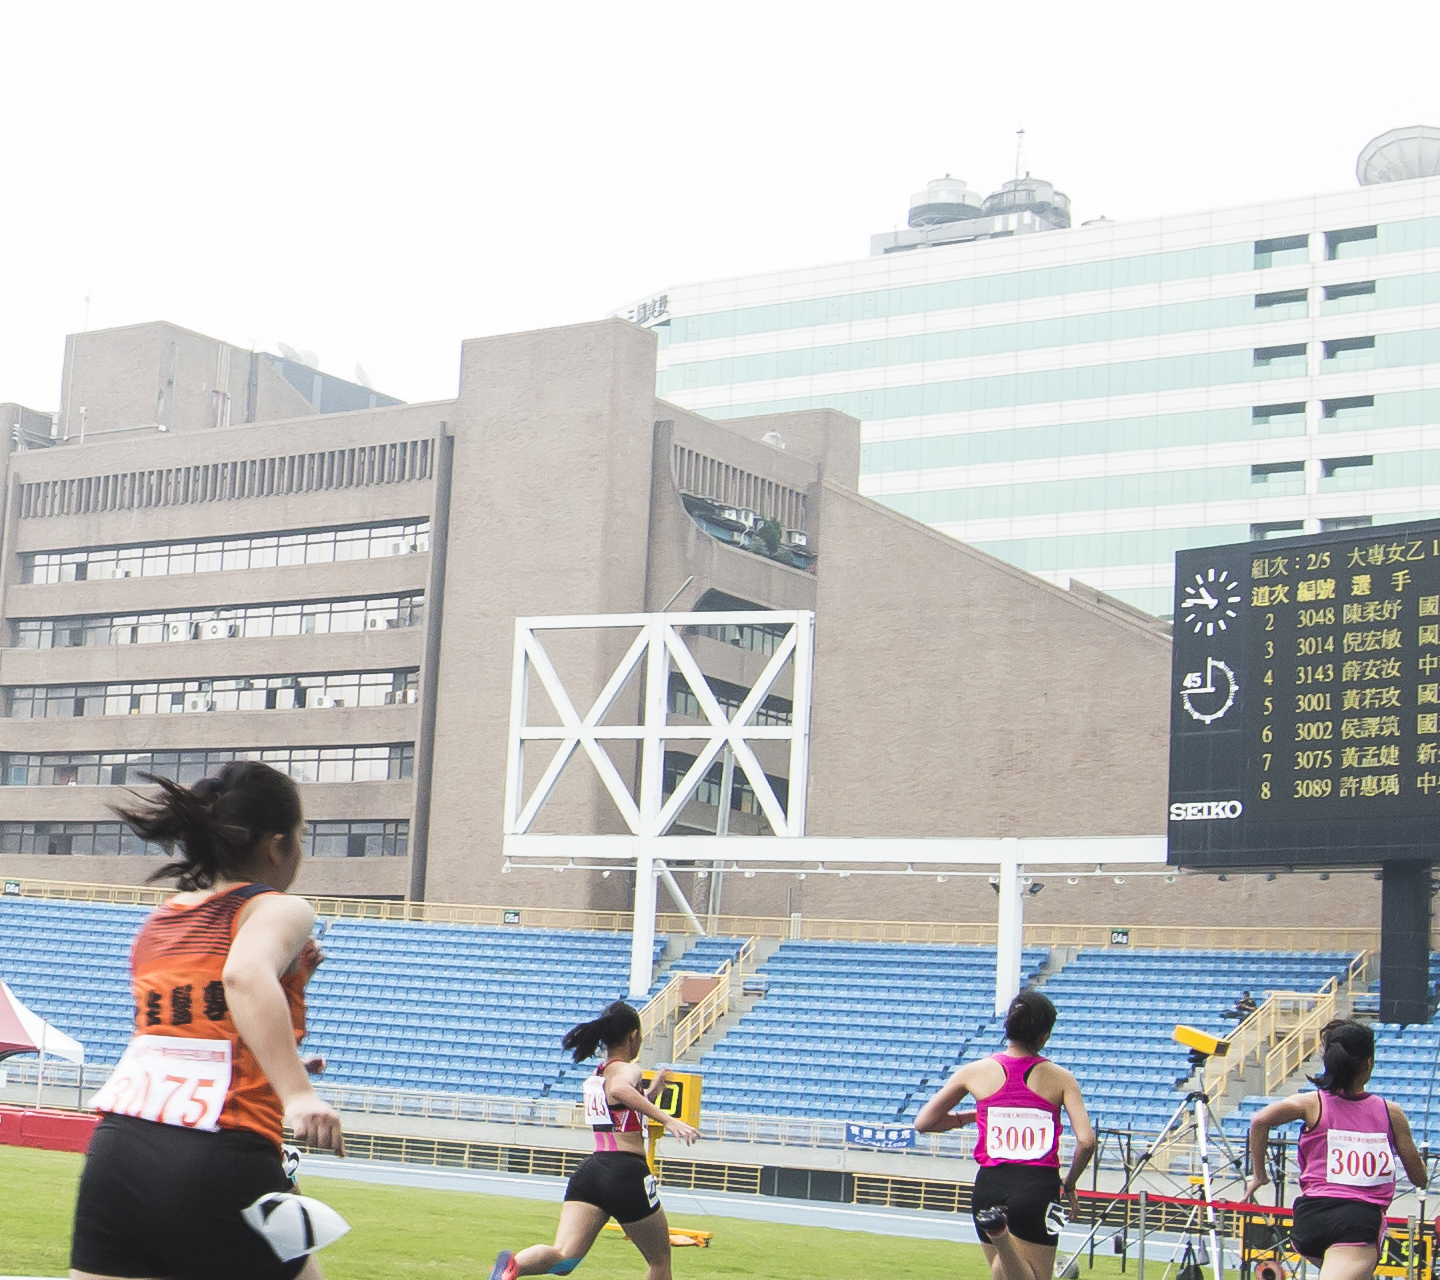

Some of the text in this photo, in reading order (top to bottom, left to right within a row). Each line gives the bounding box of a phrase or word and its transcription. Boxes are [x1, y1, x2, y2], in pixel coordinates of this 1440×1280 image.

[1347, 540, 1425, 569] 大專女乙
[1251, 583, 1289, 607] 道次
[1297, 578, 1336, 602] 編號
[1265, 613, 1274, 631] 2
[1297, 607, 1335, 628] 3048
[1264, 641, 1274, 659] 3
[1296, 635, 1334, 657] 3014
[1183, 672, 1202, 688] 45
[1263, 669, 1273, 686] 4
[1295, 664, 1334, 685] 3143
[1263, 696, 1273, 715] 5
[1295, 693, 1332, 713] 3001
[1262, 725, 1273, 743] 6
[1295, 721, 1333, 741] 3002
[1262, 753, 1272, 771] 7
[1293, 750, 1332, 770] 3075
[1261, 781, 1271, 800] 8
[1293, 779, 1332, 798] 3089
[1170, 800, 1243, 820] SEIKO
[991, 1125, 1047, 1151] 3001
[1331, 1148, 1392, 1177] 3002
